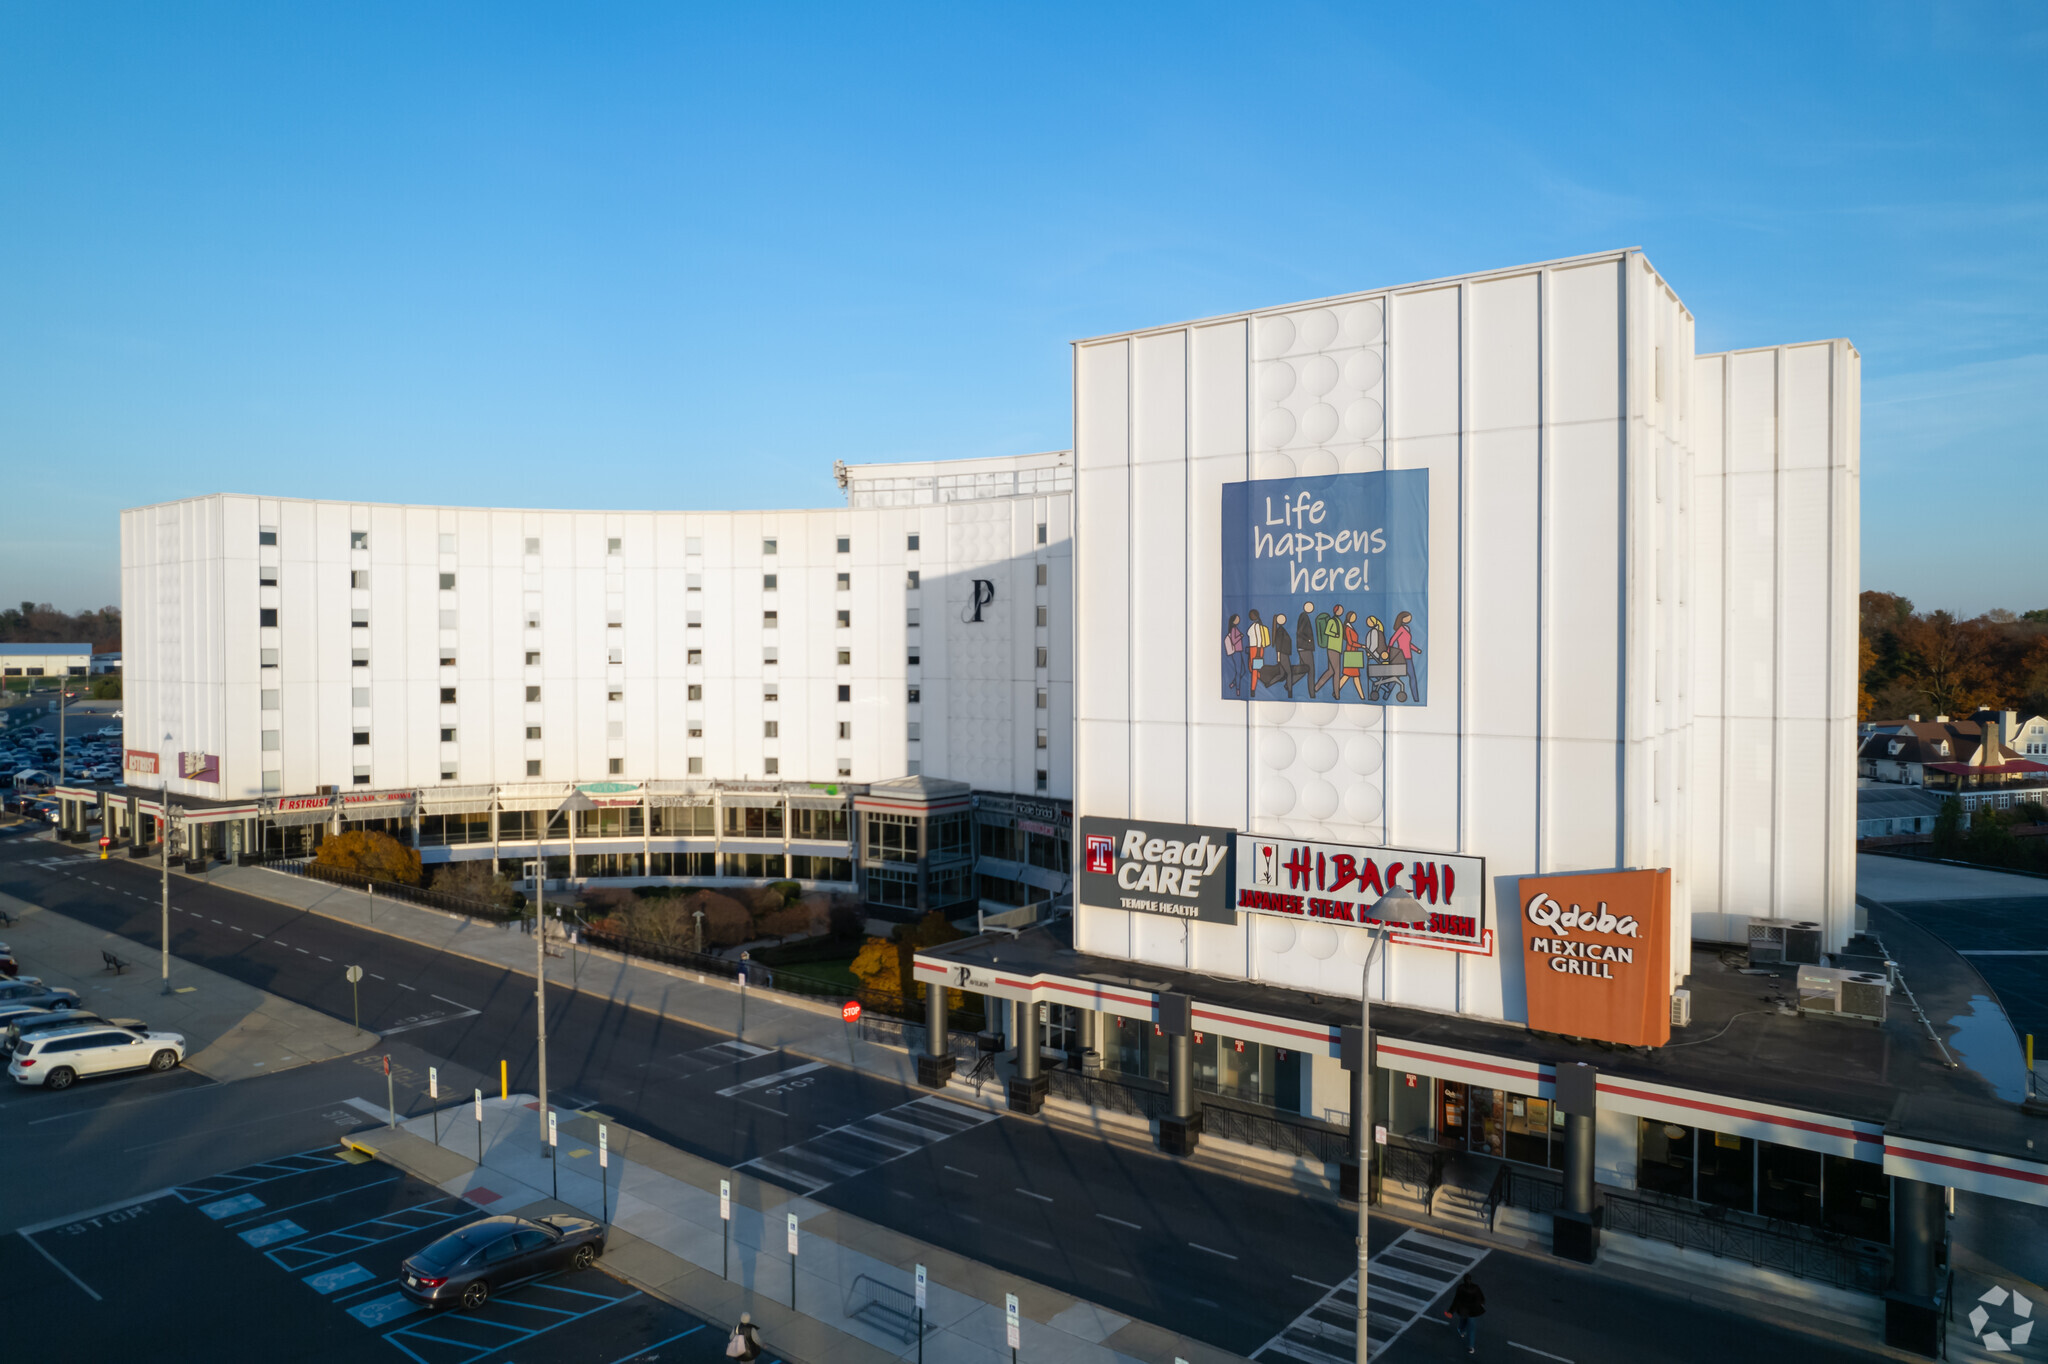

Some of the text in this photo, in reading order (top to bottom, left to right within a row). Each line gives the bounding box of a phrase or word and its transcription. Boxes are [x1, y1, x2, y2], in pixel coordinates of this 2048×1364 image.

[1266, 491, 1326, 530] Life
[1254, 525, 1387, 563] happens
[1290, 558, 1370, 594] here!
[344, 795, 375, 803] SALAD
[1119, 829, 1229, 876] Ready
[1117, 861, 1204, 898] CARE
[1282, 846, 1456, 906] HIBACHI
[1119, 897, 1199, 918] TEMPLE HEALTH
[1237, 888, 1305, 915] JAPANESE
[1308, 897, 1355, 922] STEAK
[1430, 911, 1477, 938] SUSHI
[1528, 893, 1638, 938] Qdoba
[1533, 937, 1633, 964] MEXICAN
[1551, 957, 1614, 979] GRILL
[843, 1006, 861, 1018] STOP
[764, 1076, 816, 1097] STOP
